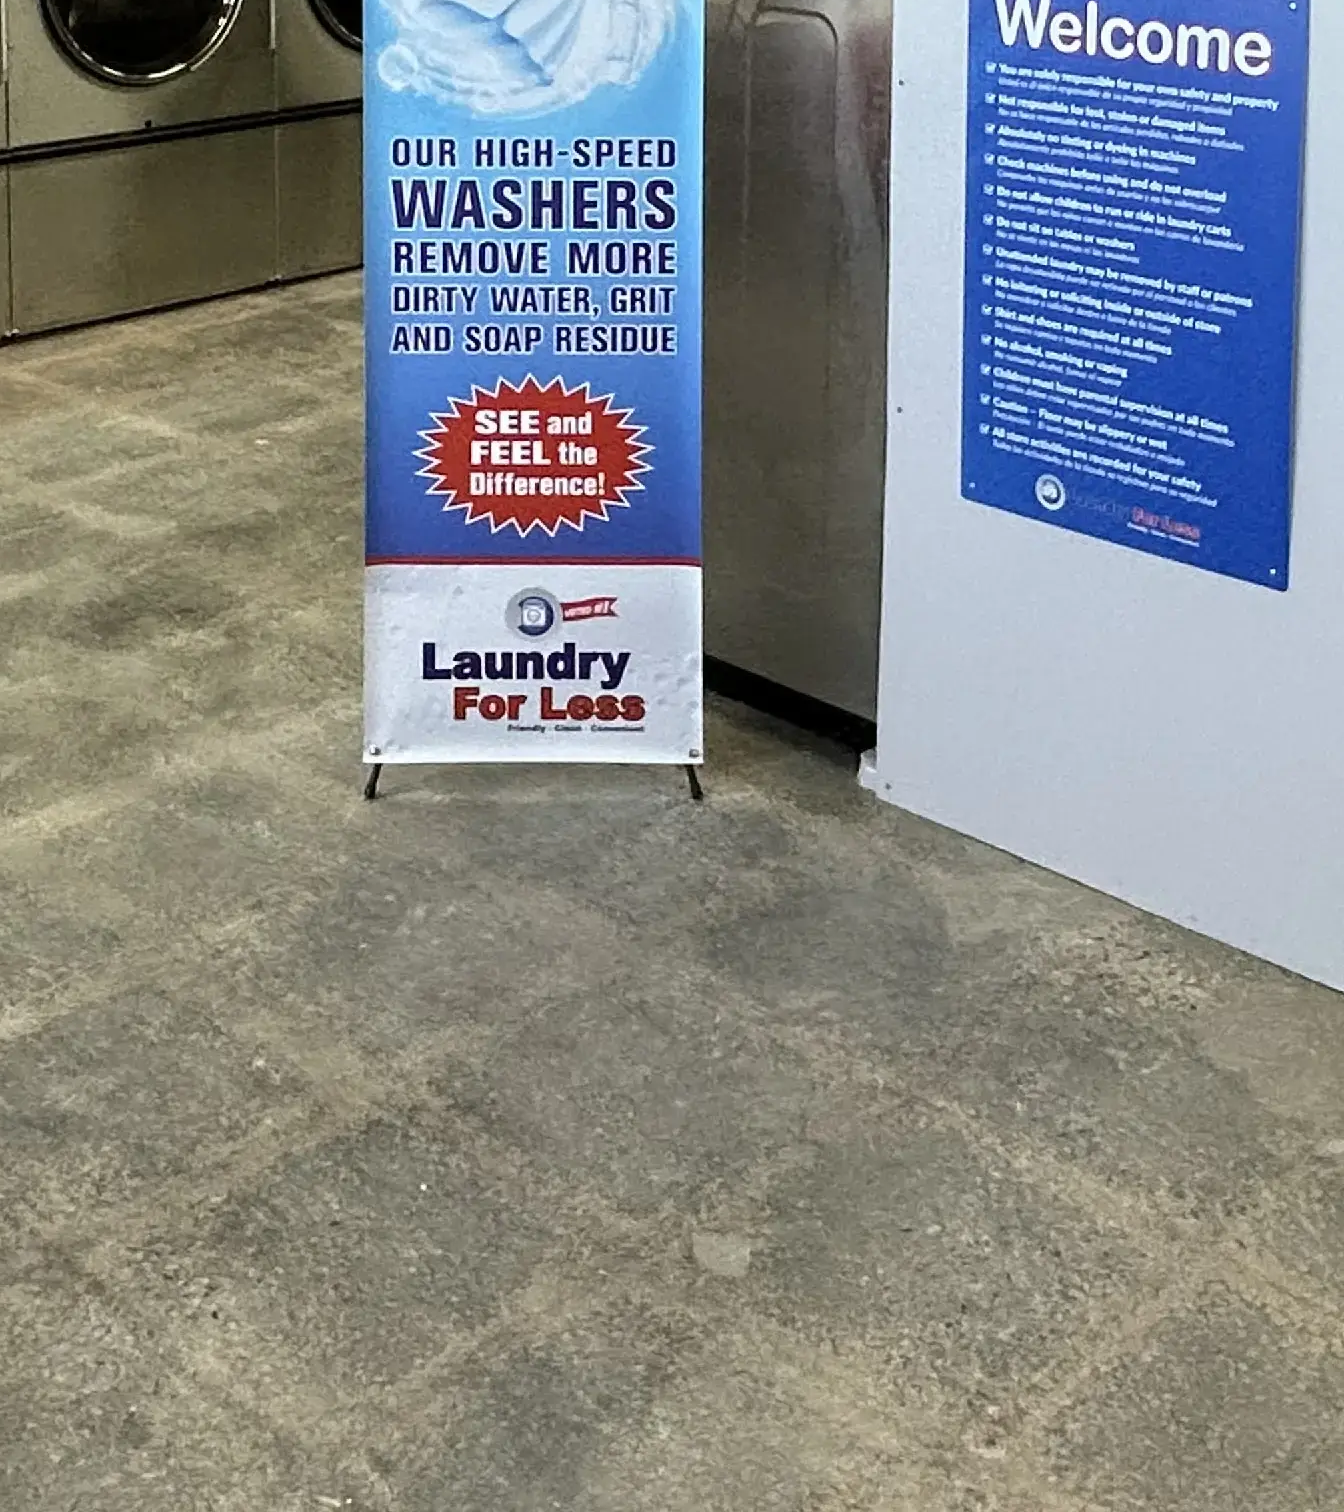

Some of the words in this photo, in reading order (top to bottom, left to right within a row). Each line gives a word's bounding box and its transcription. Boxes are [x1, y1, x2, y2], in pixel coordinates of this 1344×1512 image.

[392, 138, 457, 168] OUR
[475, 138, 676, 168] HIGH-SPEED
[392, 179, 676, 230] WASHERS
[393, 241, 549, 274] REMOVE
[568, 241, 676, 274] MORE
[392, 286, 478, 313] DIRTY
[490, 286, 600, 318] WATER,
[610, 286, 675, 314] GRIT
[392, 326, 451, 353] AND
[464, 326, 543, 353] SOAP
[555, 326, 676, 353] RESIDUE
[474, 409, 540, 435] SEE
[547, 411, 593, 435] and
[470, 440, 551, 466] FEEL
[558, 442, 598, 466] the
[469, 472, 606, 496] Difference!
[422, 642, 632, 689] Laundry
[453, 686, 527, 721] For
[540, 686, 646, 722] Less
